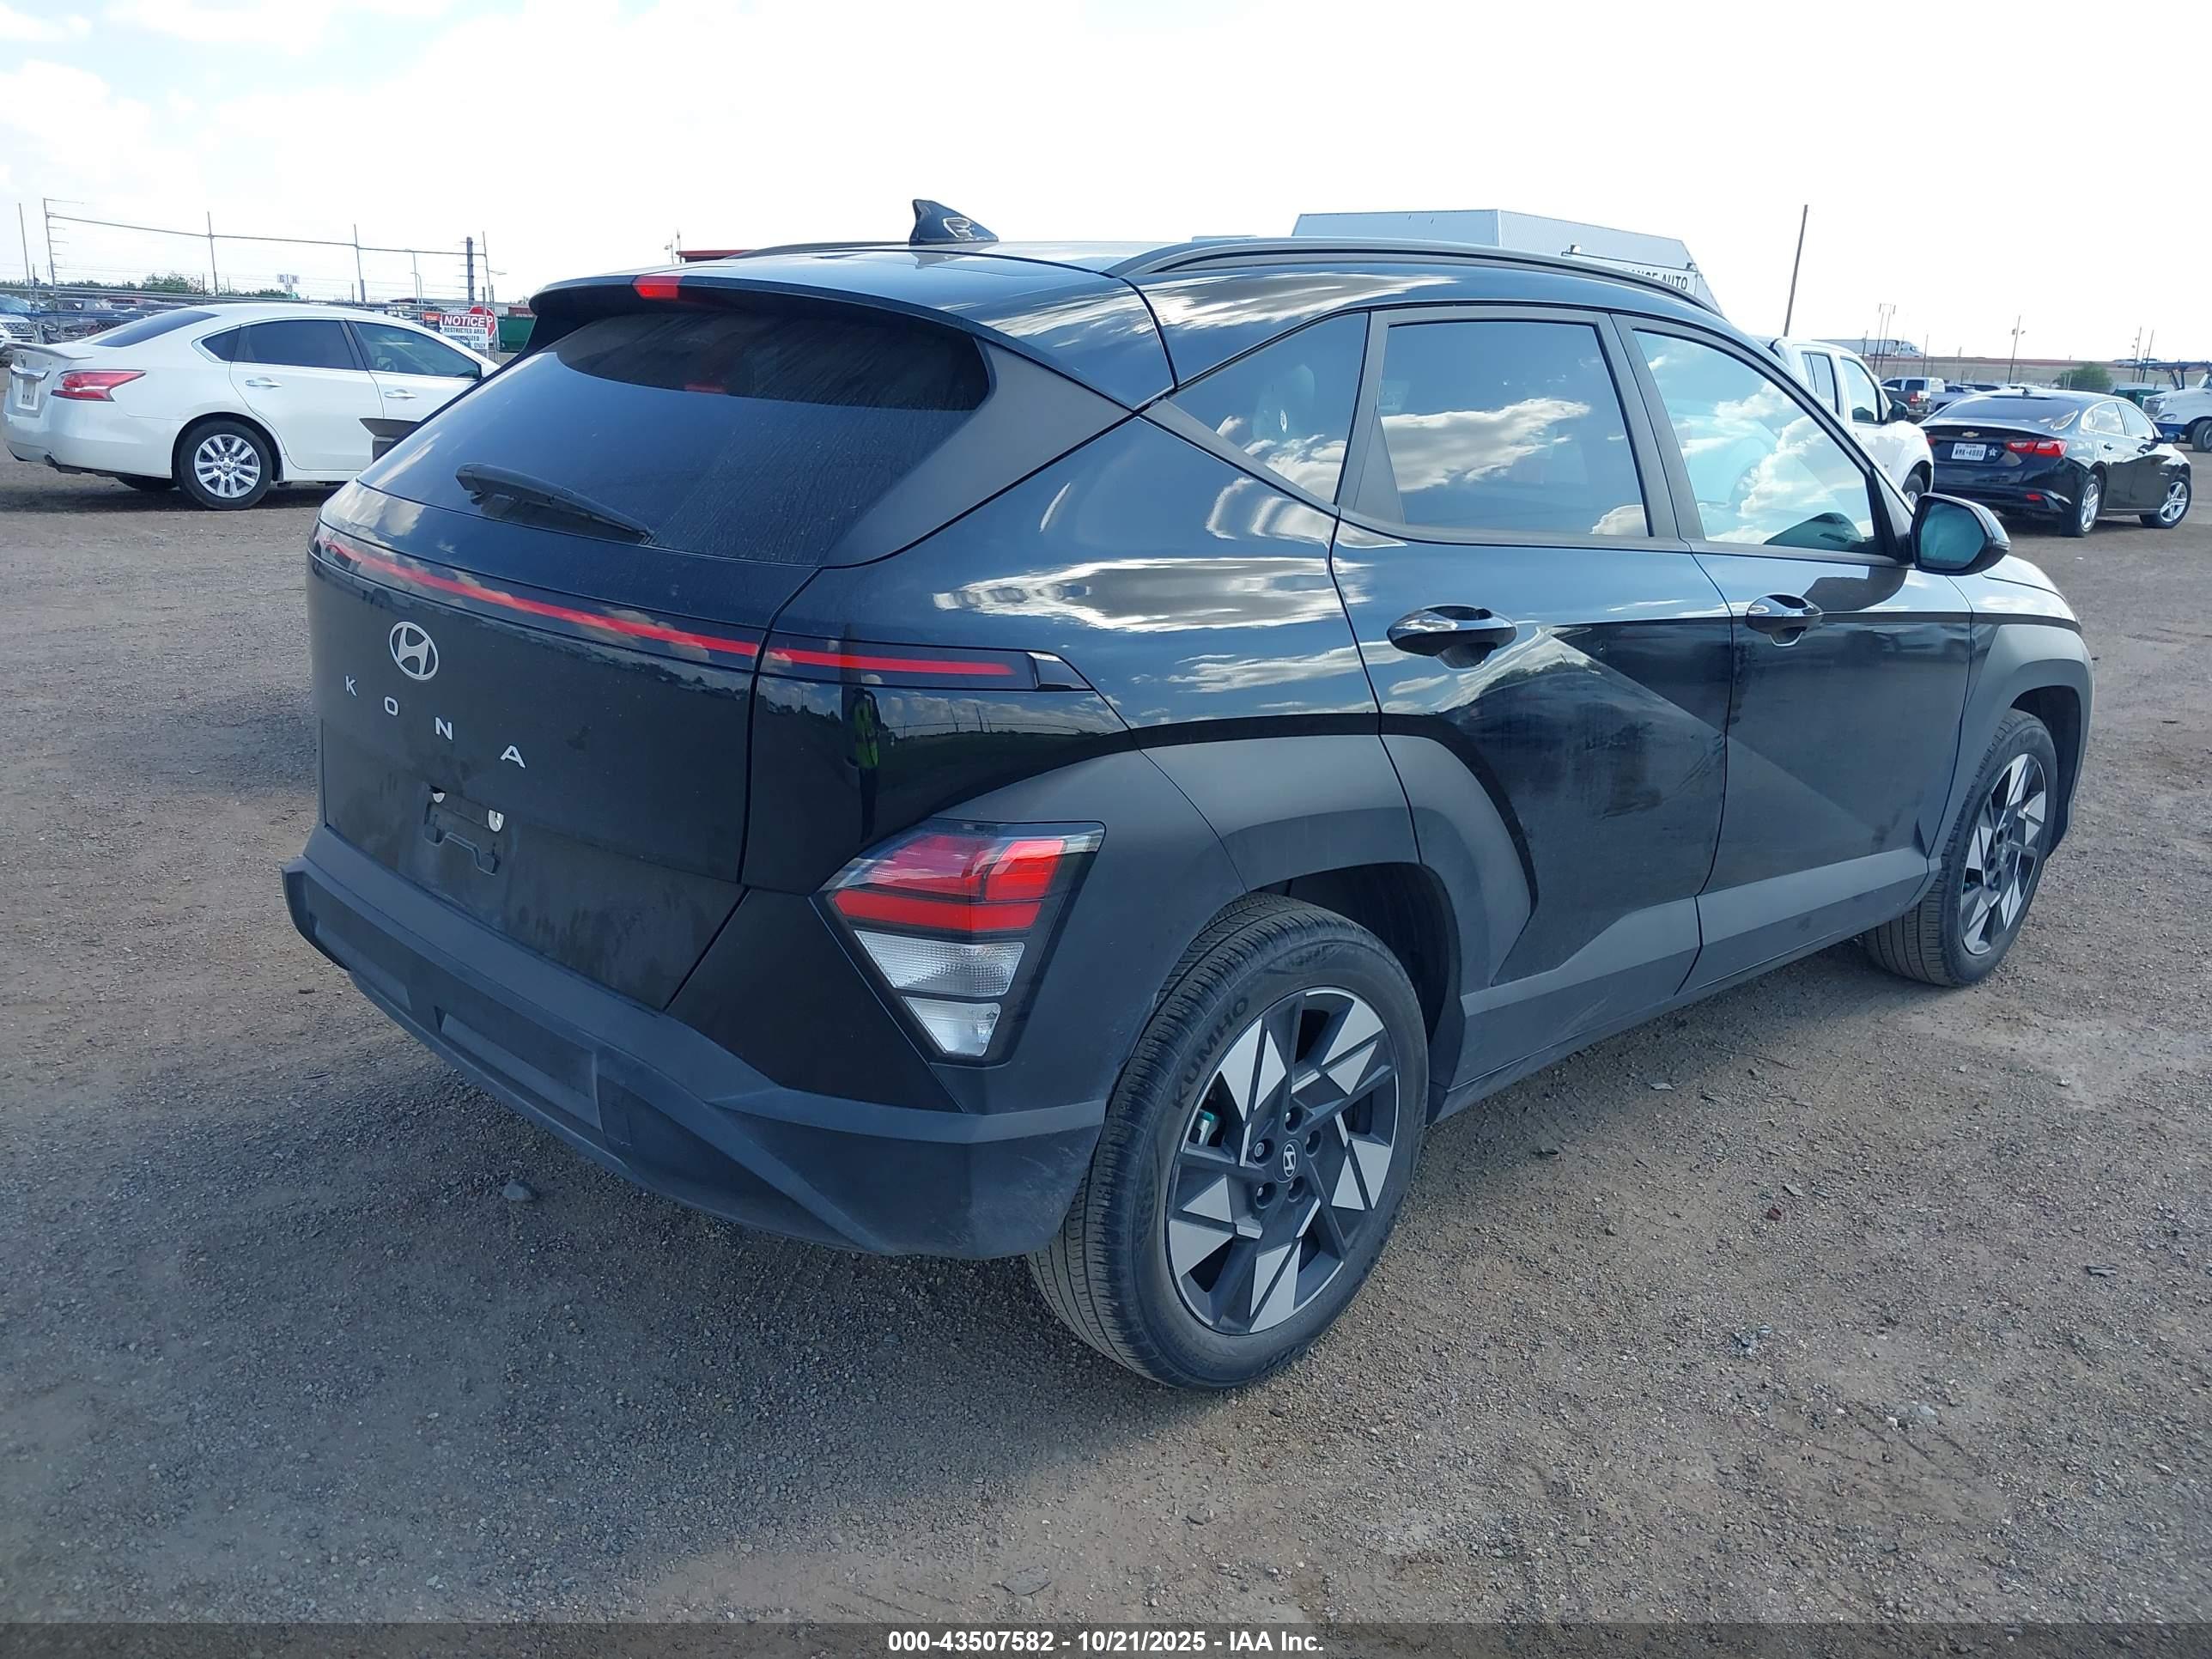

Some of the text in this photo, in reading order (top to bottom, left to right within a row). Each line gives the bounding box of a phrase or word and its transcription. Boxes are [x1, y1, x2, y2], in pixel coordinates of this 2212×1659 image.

[444, 315, 485, 327] NOTICE
[344, 675, 526, 769] KONA
[1172, 996, 1249, 1109] KUMHO
